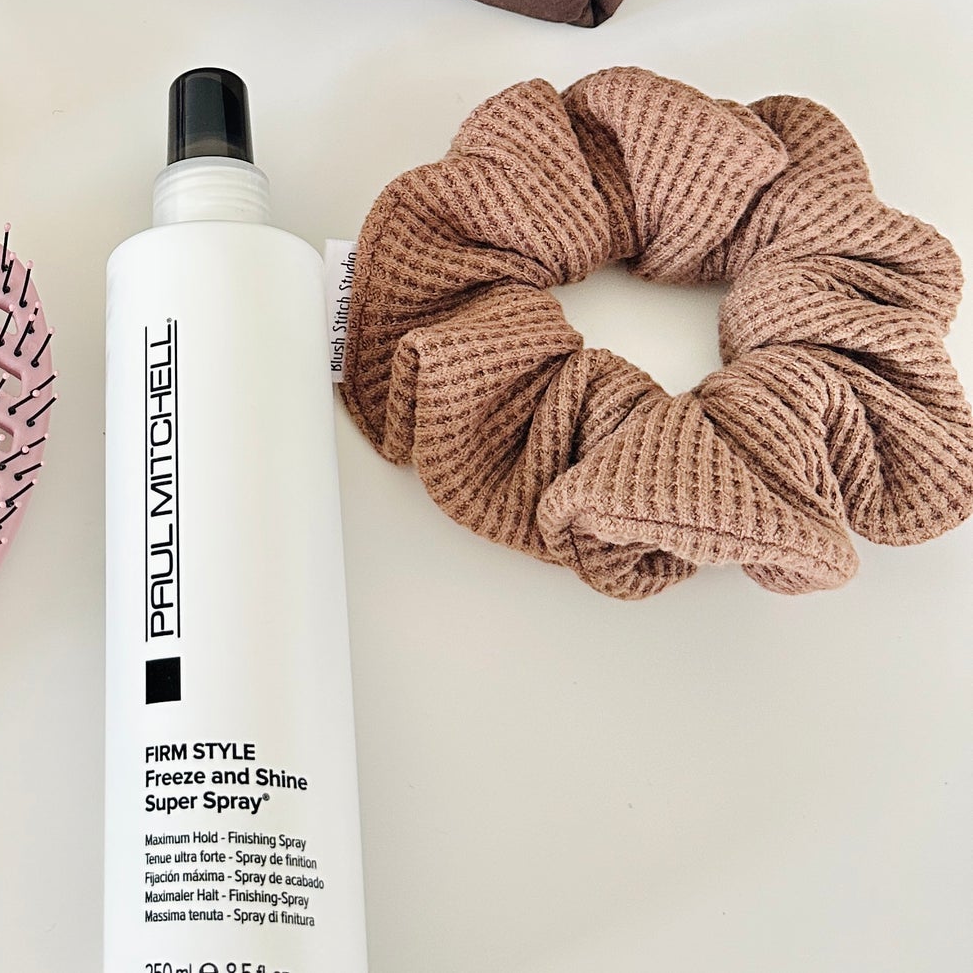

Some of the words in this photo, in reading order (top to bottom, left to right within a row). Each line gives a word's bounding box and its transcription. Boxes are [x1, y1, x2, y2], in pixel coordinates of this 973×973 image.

[339, 251, 358, 291] Studio
[332, 296, 352, 333] Stitch
[330, 337, 346, 372] Blush
[150, 522, 174, 638] PAUL
[144, 743, 188, 763] FIRM
[192, 742, 256, 761] STYLE
[144, 769, 206, 788] Freeze
[211, 767, 250, 785] and
[255, 767, 308, 790] Shine
[144, 793, 198, 814] Super
[144, 831, 191, 846] Maximum
[192, 830, 219, 844] Hold
[227, 830, 277, 849] Finishing
[278, 834, 307, 852] Spray
[144, 852, 172, 865] Tenue
[174, 850, 197, 863] ultra
[199, 849, 226, 863] forte
[235, 850, 267, 867] Spray
[269, 852, 284, 865] de
[284, 853, 318, 870] finition
[144, 871, 180, 887] Fijación
[182, 869, 225, 883] máxima
[234, 869, 267, 887] Spray
[268, 872, 283, 885] de
[284, 874, 325, 890] acabado
[144, 889, 195, 903] Maximaler
[196, 888, 220, 902] Halt
[228, 888, 310, 910] Finishing-Spray
[144, 909, 186, 923] Massima
[188, 908, 224, 921] tenuta
[233, 908, 266, 925] Spray
[268, 910, 279, 923] di
[280, 911, 315, 927] finitura
